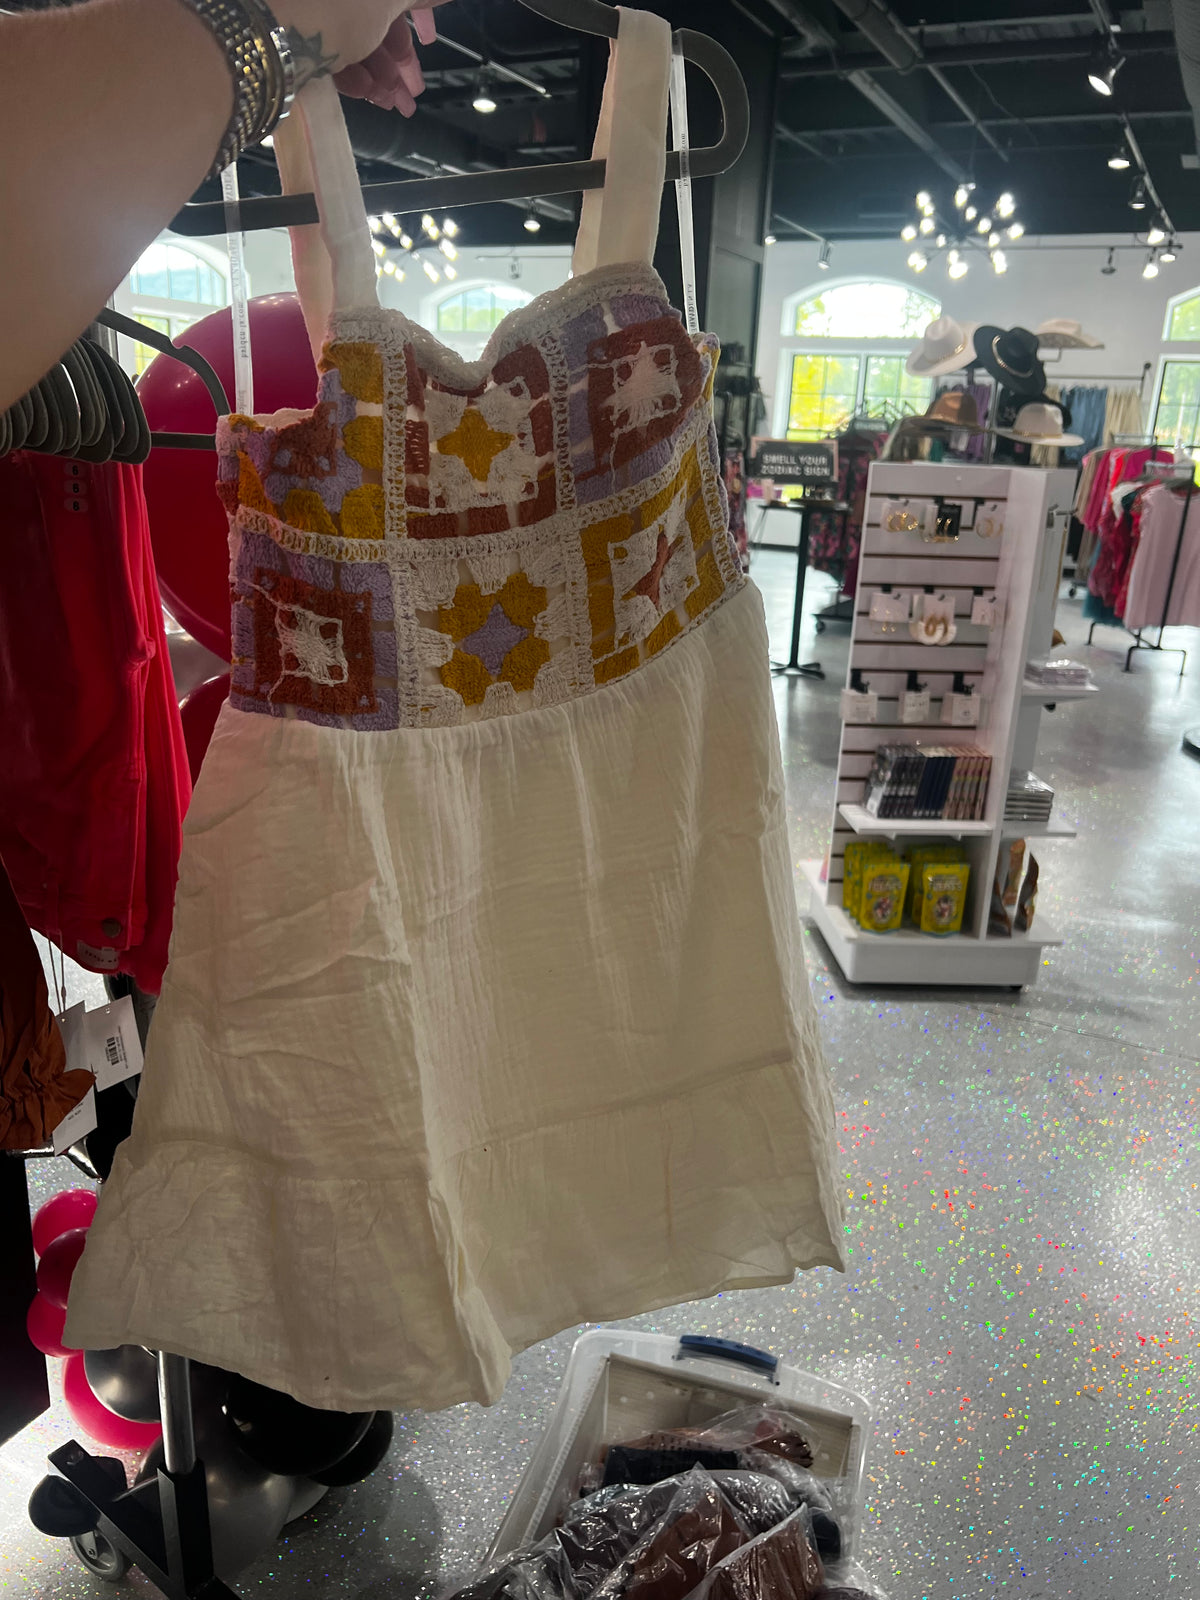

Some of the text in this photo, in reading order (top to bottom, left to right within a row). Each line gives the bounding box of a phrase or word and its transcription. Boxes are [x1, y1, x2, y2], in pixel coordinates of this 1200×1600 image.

[762, 454, 828, 466] SMELL YOUR
[761, 464, 830, 476] ZODIAC SIGN
